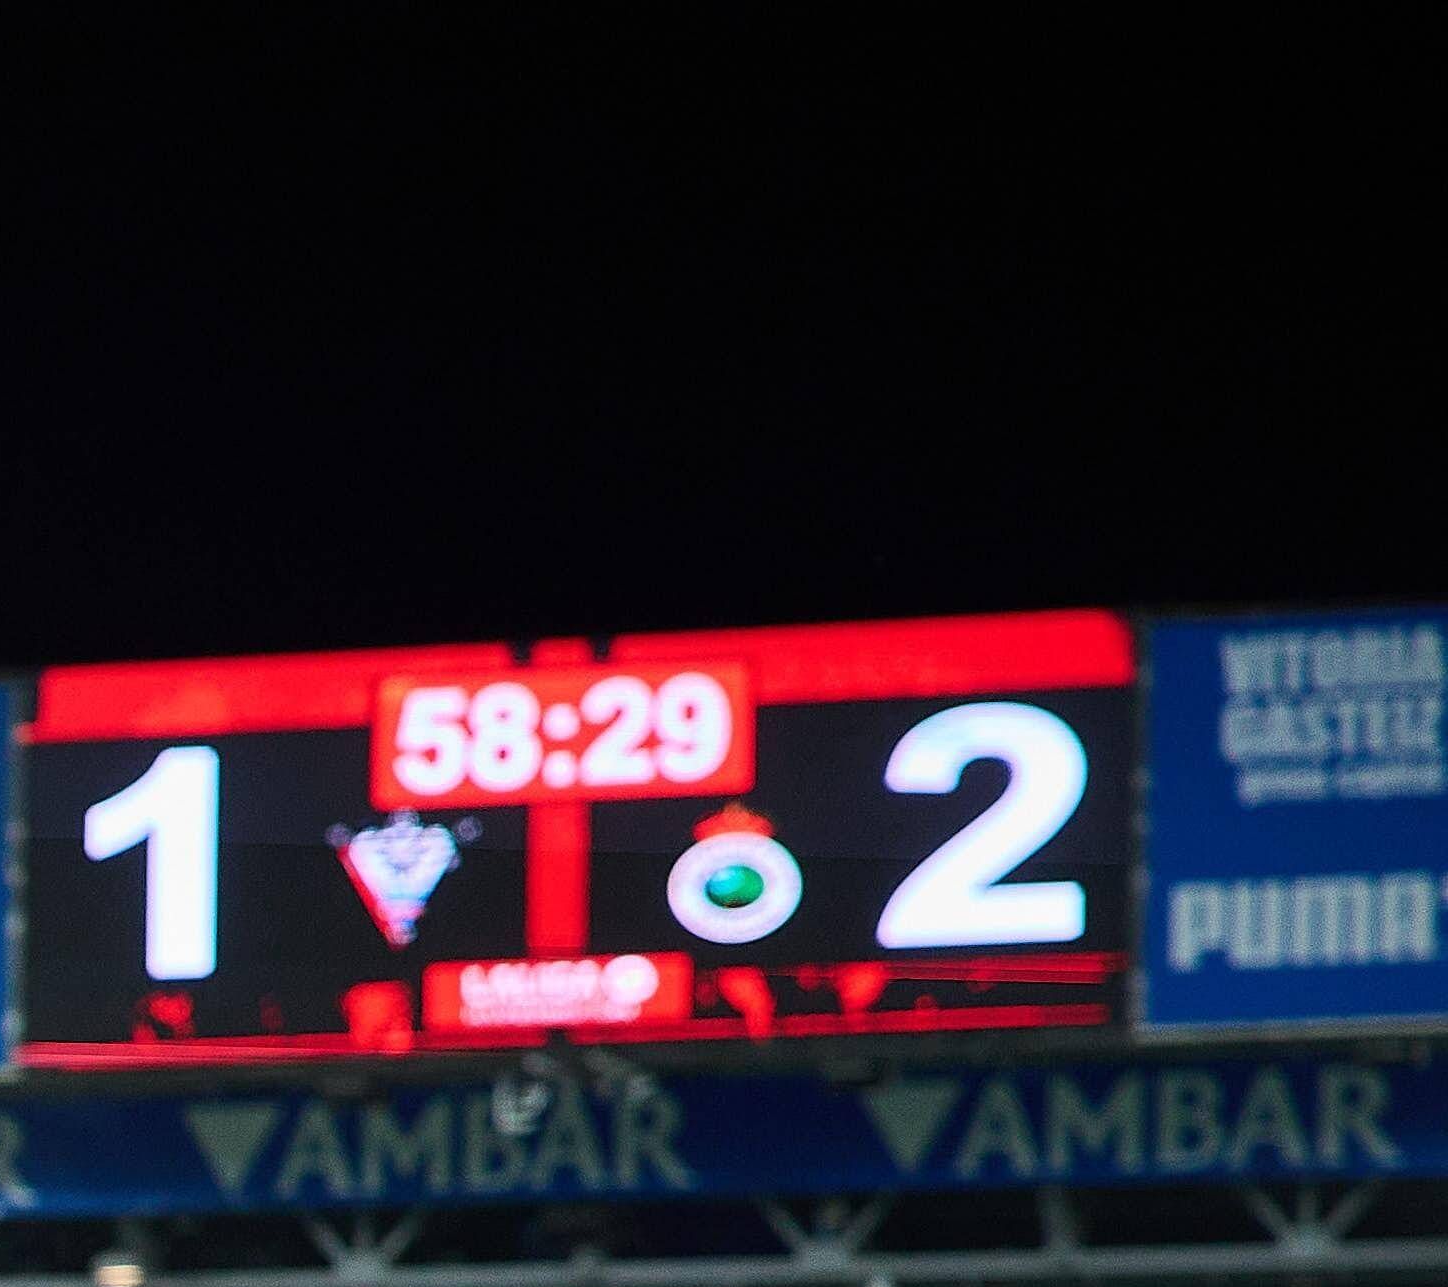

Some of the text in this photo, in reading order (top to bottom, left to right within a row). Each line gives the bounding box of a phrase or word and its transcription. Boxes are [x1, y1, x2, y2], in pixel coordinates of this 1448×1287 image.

[392, 672, 731, 795] 58:29
[84, 746, 220, 980] 1
[876, 702, 1088, 949] 2
[1167, 871, 1439, 975] PUMA
[274, 1078, 698, 1198] AMBAR
[954, 1065, 1408, 1183] AMBAR
